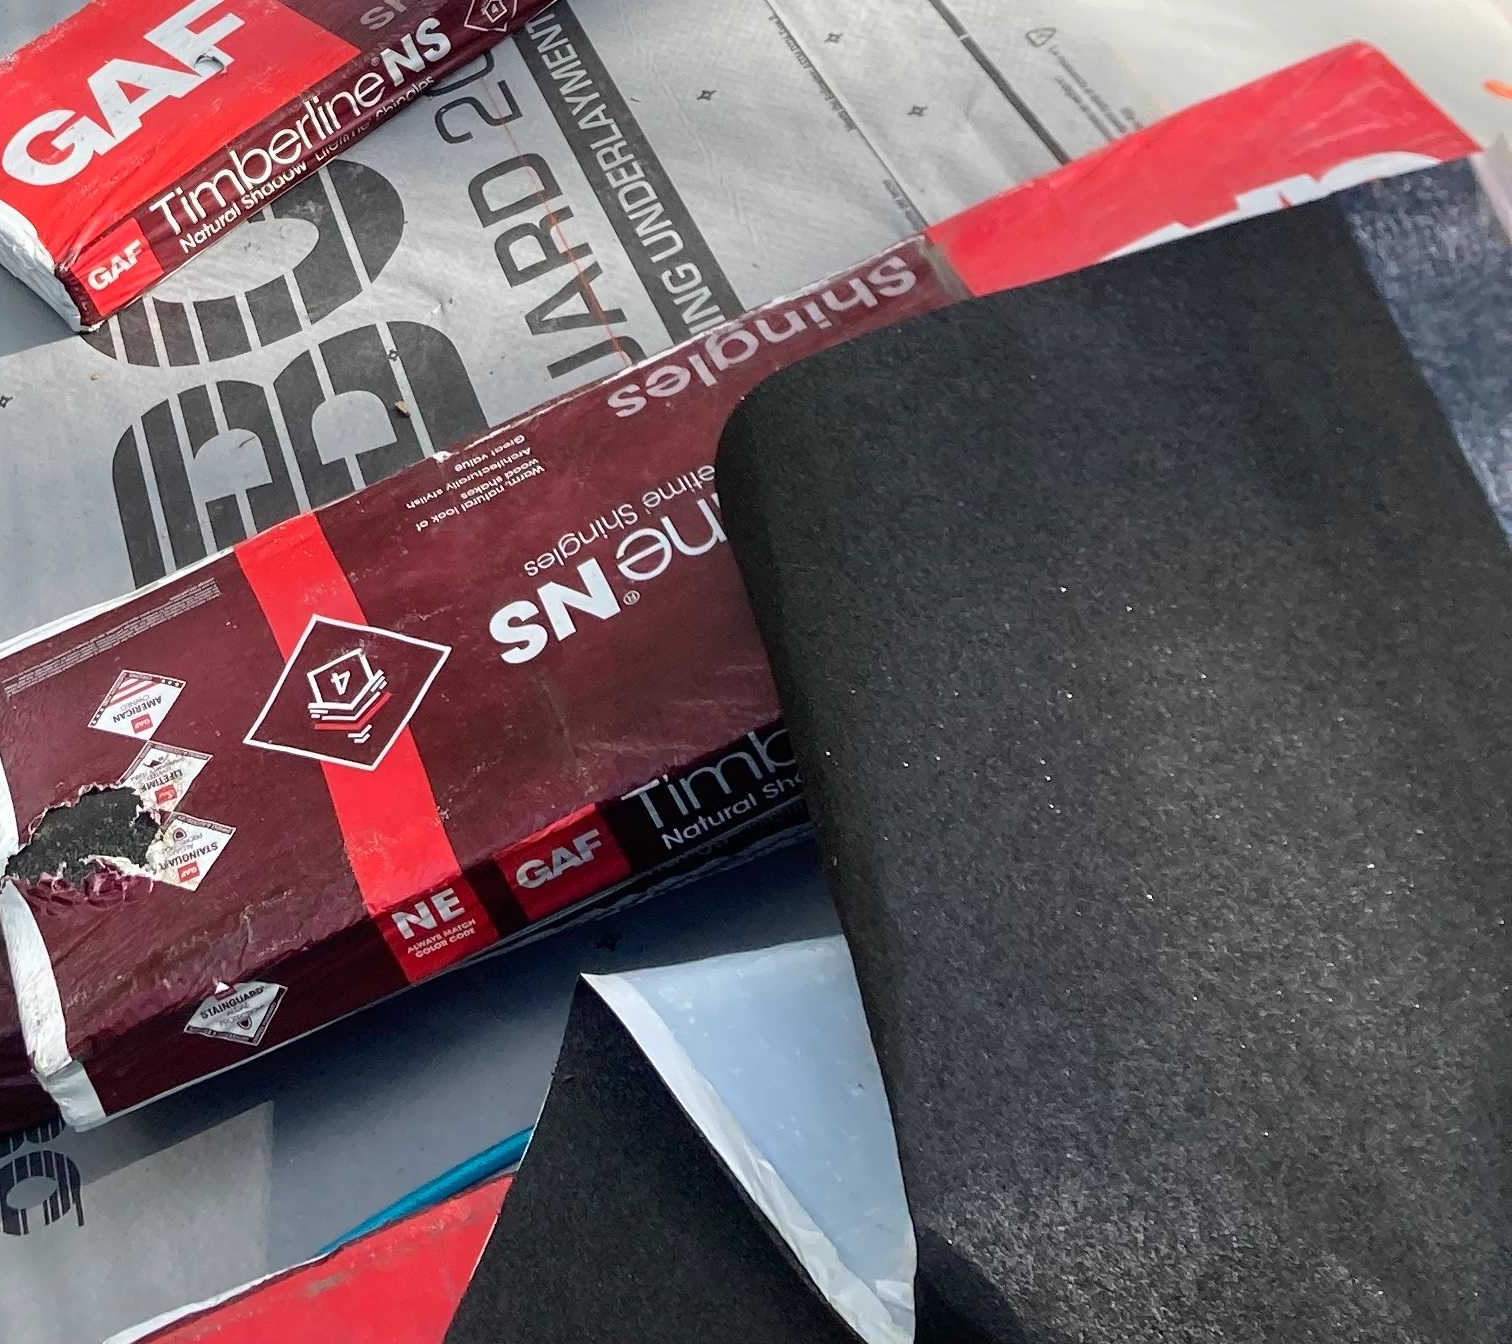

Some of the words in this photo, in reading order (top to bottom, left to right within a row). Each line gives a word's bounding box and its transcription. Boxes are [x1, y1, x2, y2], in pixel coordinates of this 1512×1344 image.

[148, 72, 386, 236] Timberline
[378, 17, 452, 87] NS
[526, 14, 685, 263] UNDERLAYMENT
[179, 203, 241, 254] Natural
[88, 239, 145, 292] GAF
[607, 253, 917, 419] Shingles
[454, 448, 496, 473] value
[497, 434, 526, 456] Great
[445, 446, 532, 492] Architecturally
[460, 470, 504, 500] shakes
[503, 457, 539, 478] wood
[405, 485, 445, 511] stylish
[432, 502, 465, 525] look
[466, 482, 506, 513] natural
[415, 518, 430, 533] of
[523, 504, 640, 578] Shingles
[615, 494, 731, 583] ne
[489, 556, 621, 665] NS
[329, 669, 350, 696] 4
[111, 694, 163, 724] AMERICAN
[119, 694, 151, 712] OWNED
[660, 792, 758, 851] Natural
[515, 827, 603, 890] GAF
[391, 887, 466, 940] NE
[406, 930, 442, 956] ALWAYS
[441, 918, 477, 939] MATCH
[414, 939, 448, 960] COLOR
[447, 927, 477, 946] CODE
[199, 985, 265, 1020] STAINGUARD
